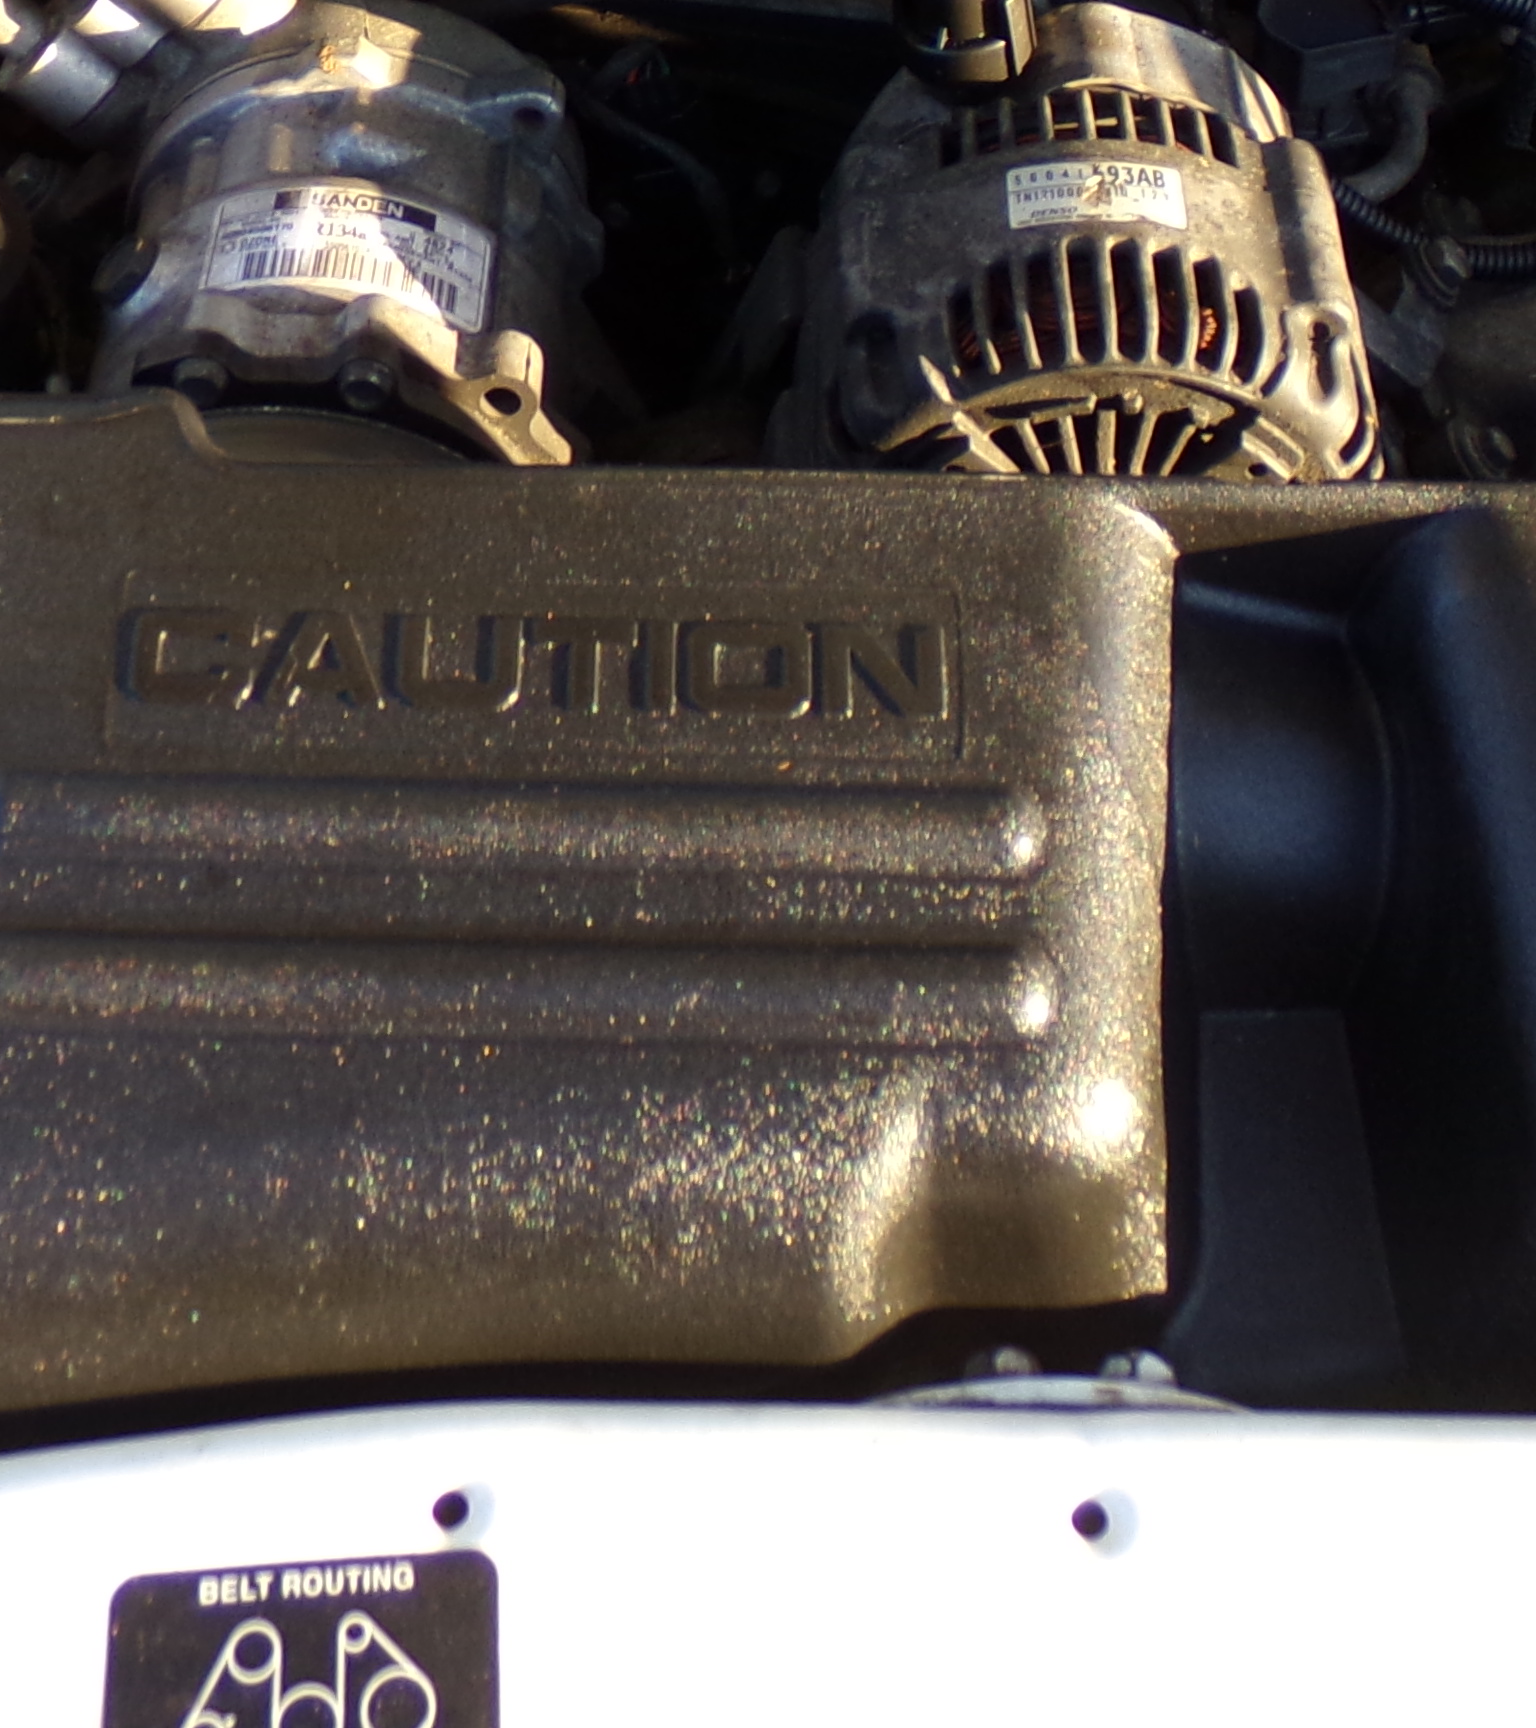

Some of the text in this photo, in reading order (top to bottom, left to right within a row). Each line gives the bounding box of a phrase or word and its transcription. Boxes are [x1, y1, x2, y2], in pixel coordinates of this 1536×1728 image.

[114, 604, 949, 719] CAUTION
[198, 1560, 415, 1606] BELT ROUTING
